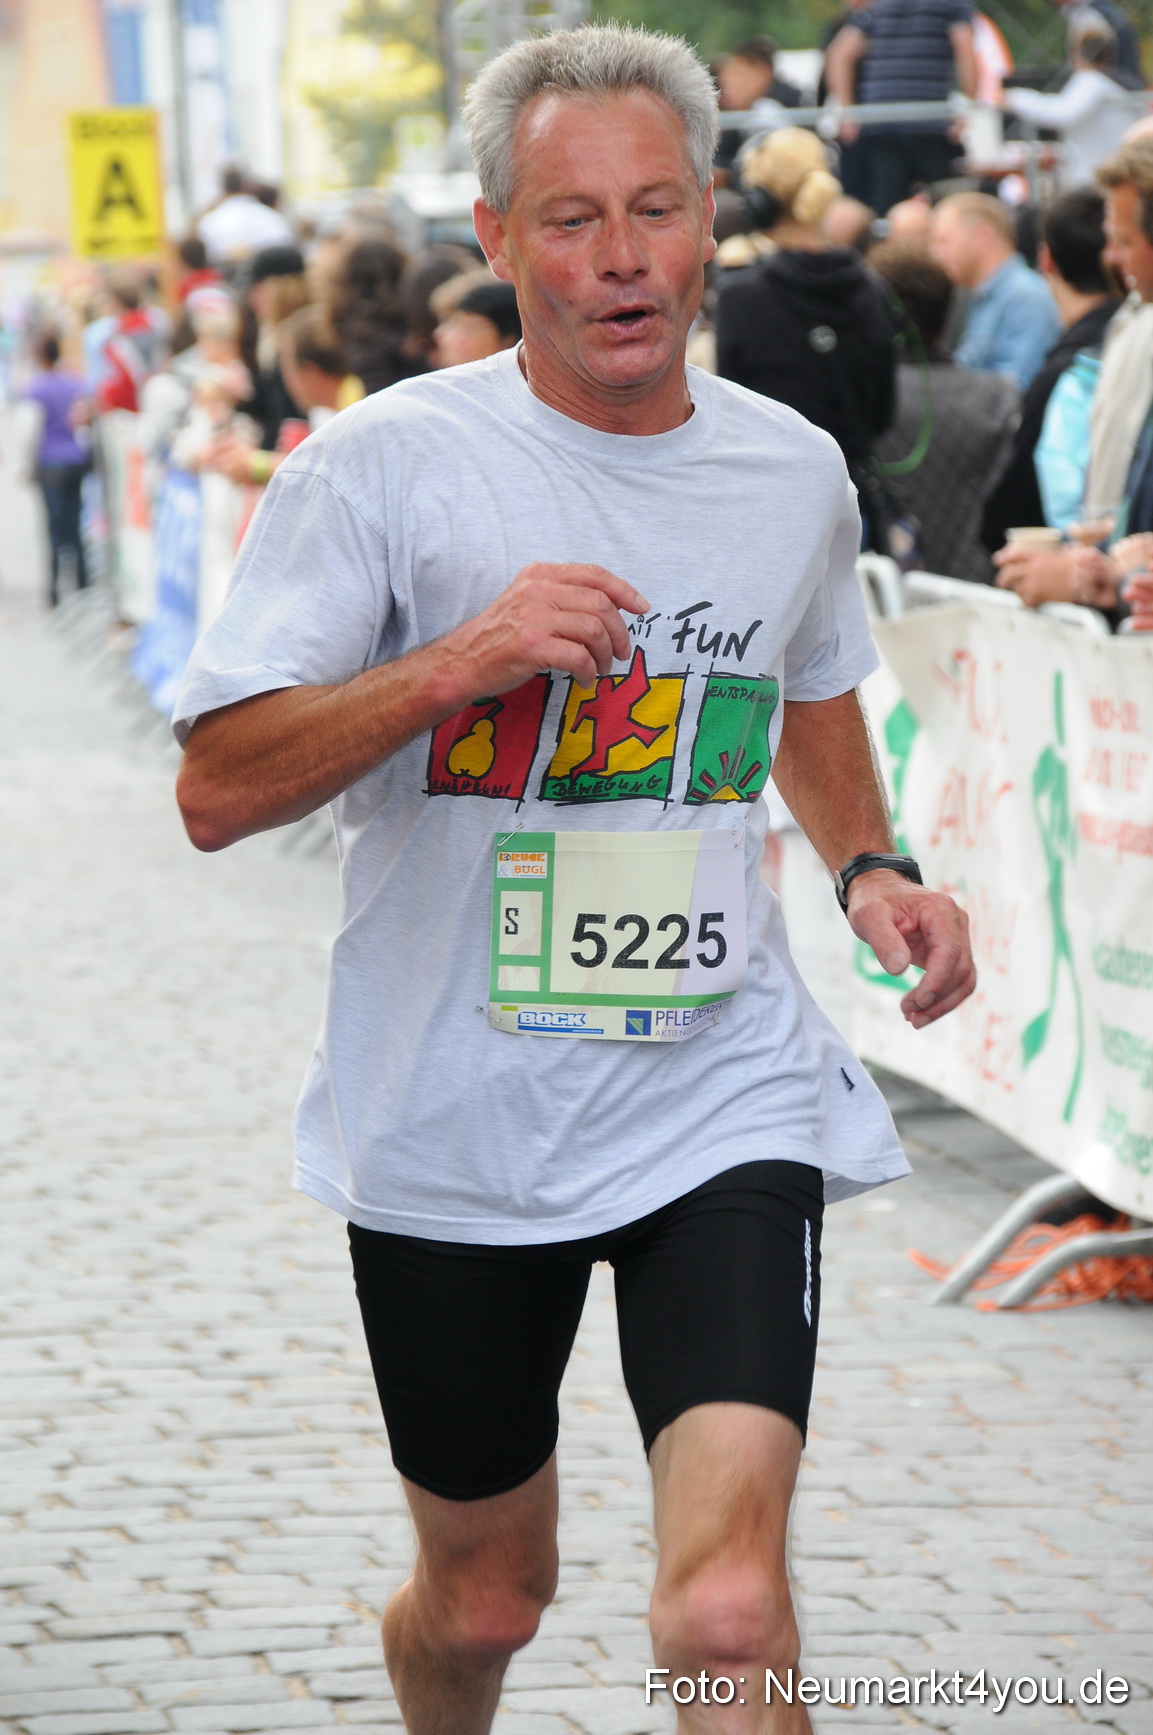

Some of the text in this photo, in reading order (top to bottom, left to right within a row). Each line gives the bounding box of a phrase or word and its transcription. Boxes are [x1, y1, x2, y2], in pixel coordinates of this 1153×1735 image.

[92, 155, 148, 224] A
[671, 600, 763, 663] FUN
[550, 773, 663, 797] BEWEGUNG
[513, 864, 546, 875] BÜGL
[504, 907, 519, 935] S
[570, 912, 728, 970] 5225
[517, 1011, 587, 1027] BOCK
